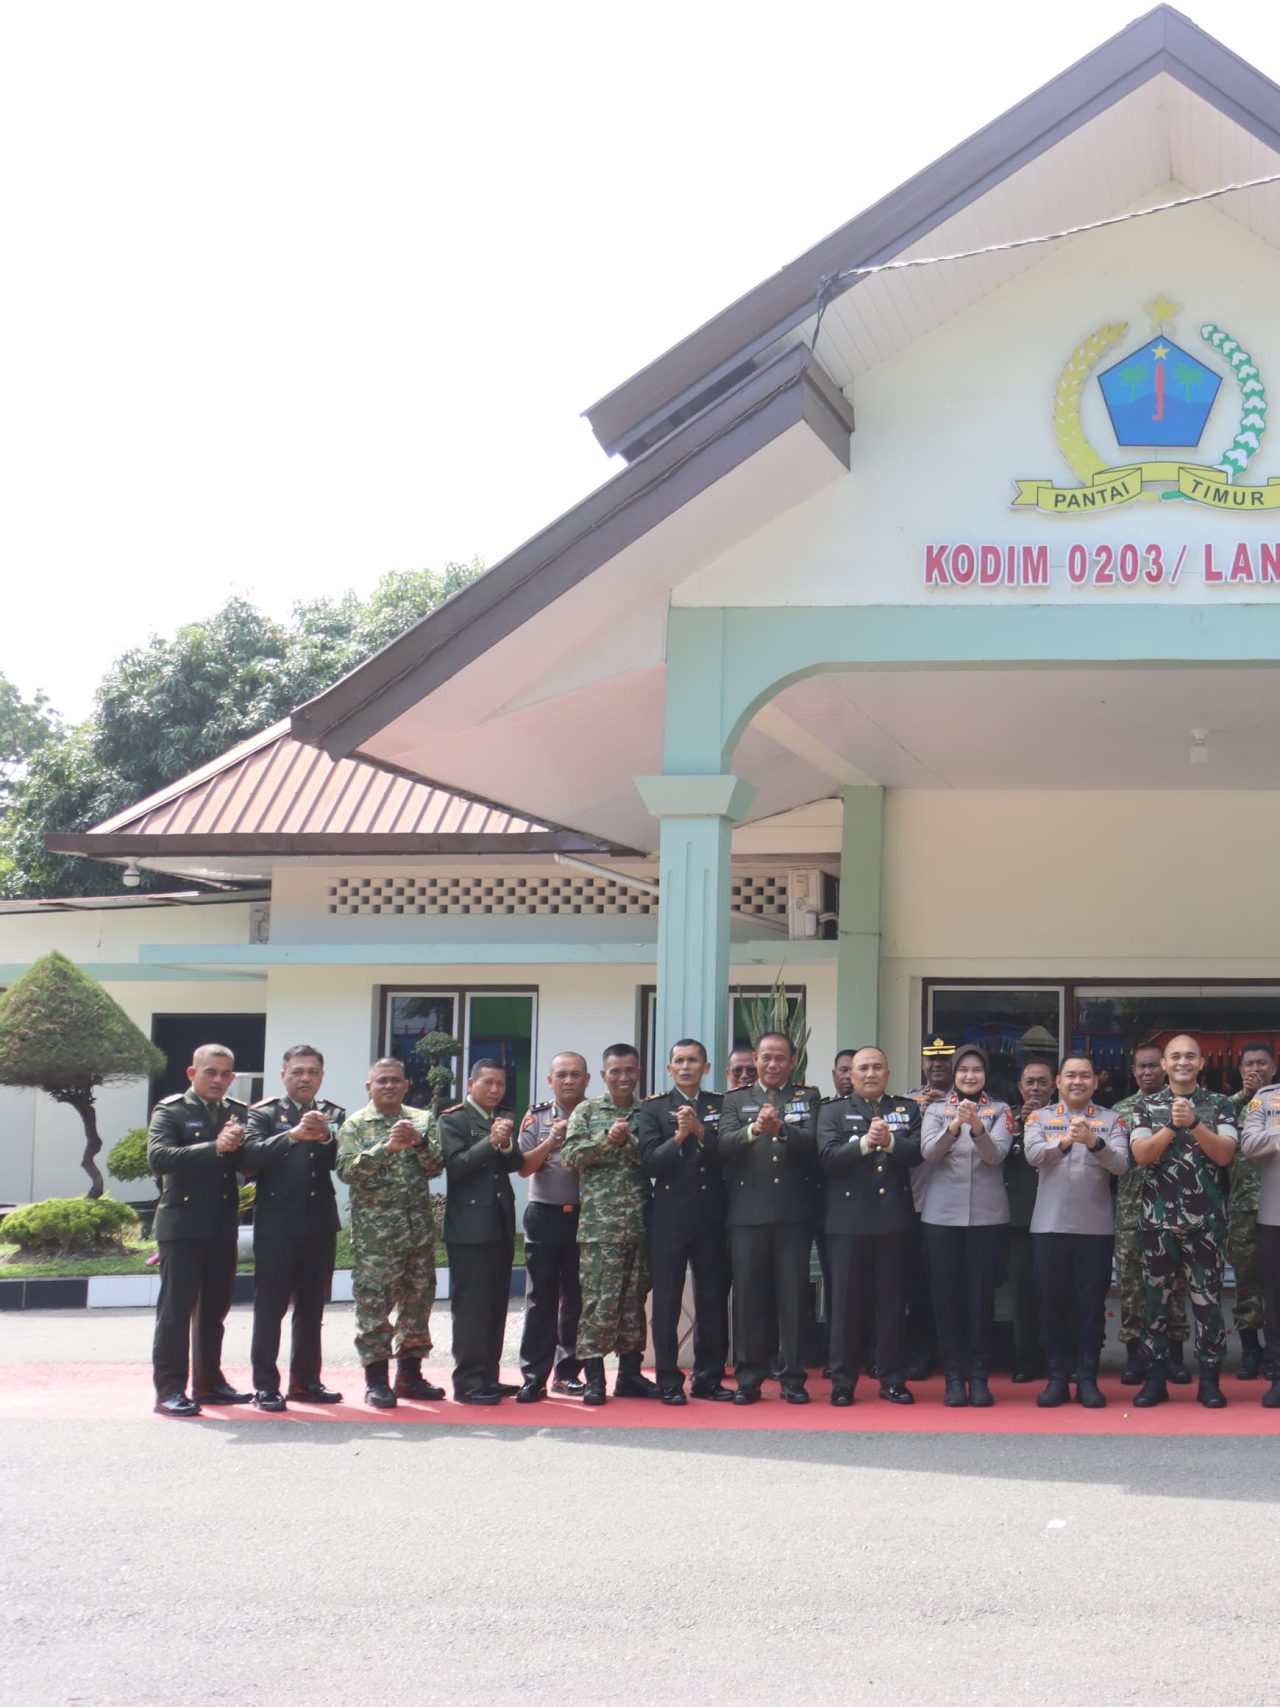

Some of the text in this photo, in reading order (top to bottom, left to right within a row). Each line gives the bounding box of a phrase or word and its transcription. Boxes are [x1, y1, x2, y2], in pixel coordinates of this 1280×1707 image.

[1054, 479, 1265, 508] PANTAI TIMUR
[924, 543, 1050, 585] KODIM
